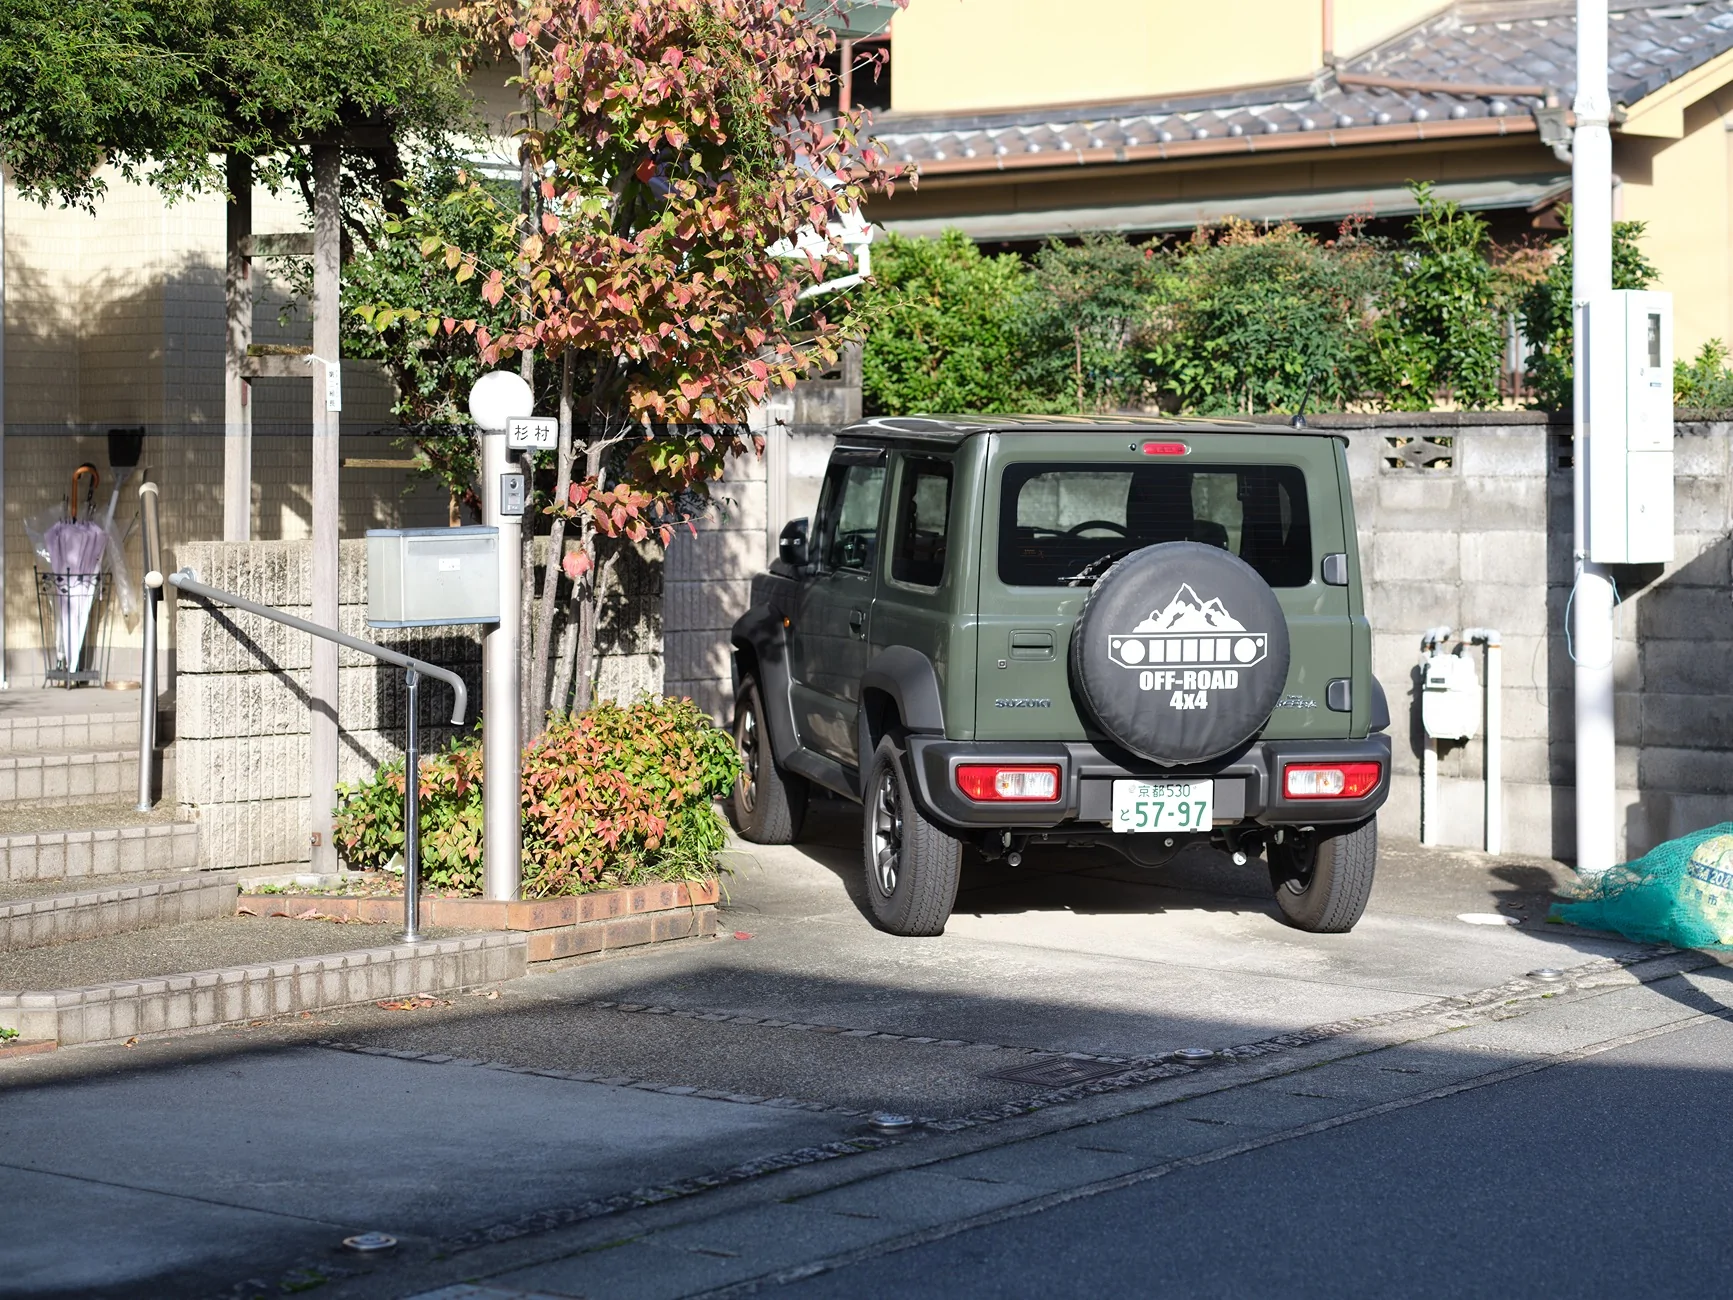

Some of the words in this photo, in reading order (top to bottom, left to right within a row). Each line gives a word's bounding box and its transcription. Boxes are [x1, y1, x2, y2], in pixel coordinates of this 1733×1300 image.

[513, 424, 550, 442] 杉村
[1139, 670, 1239, 691] OFF-ROAD
[994, 698, 1050, 708] SUZUKI
[1169, 690, 1209, 710] 4x4
[1135, 801, 1207, 827] 57-97
